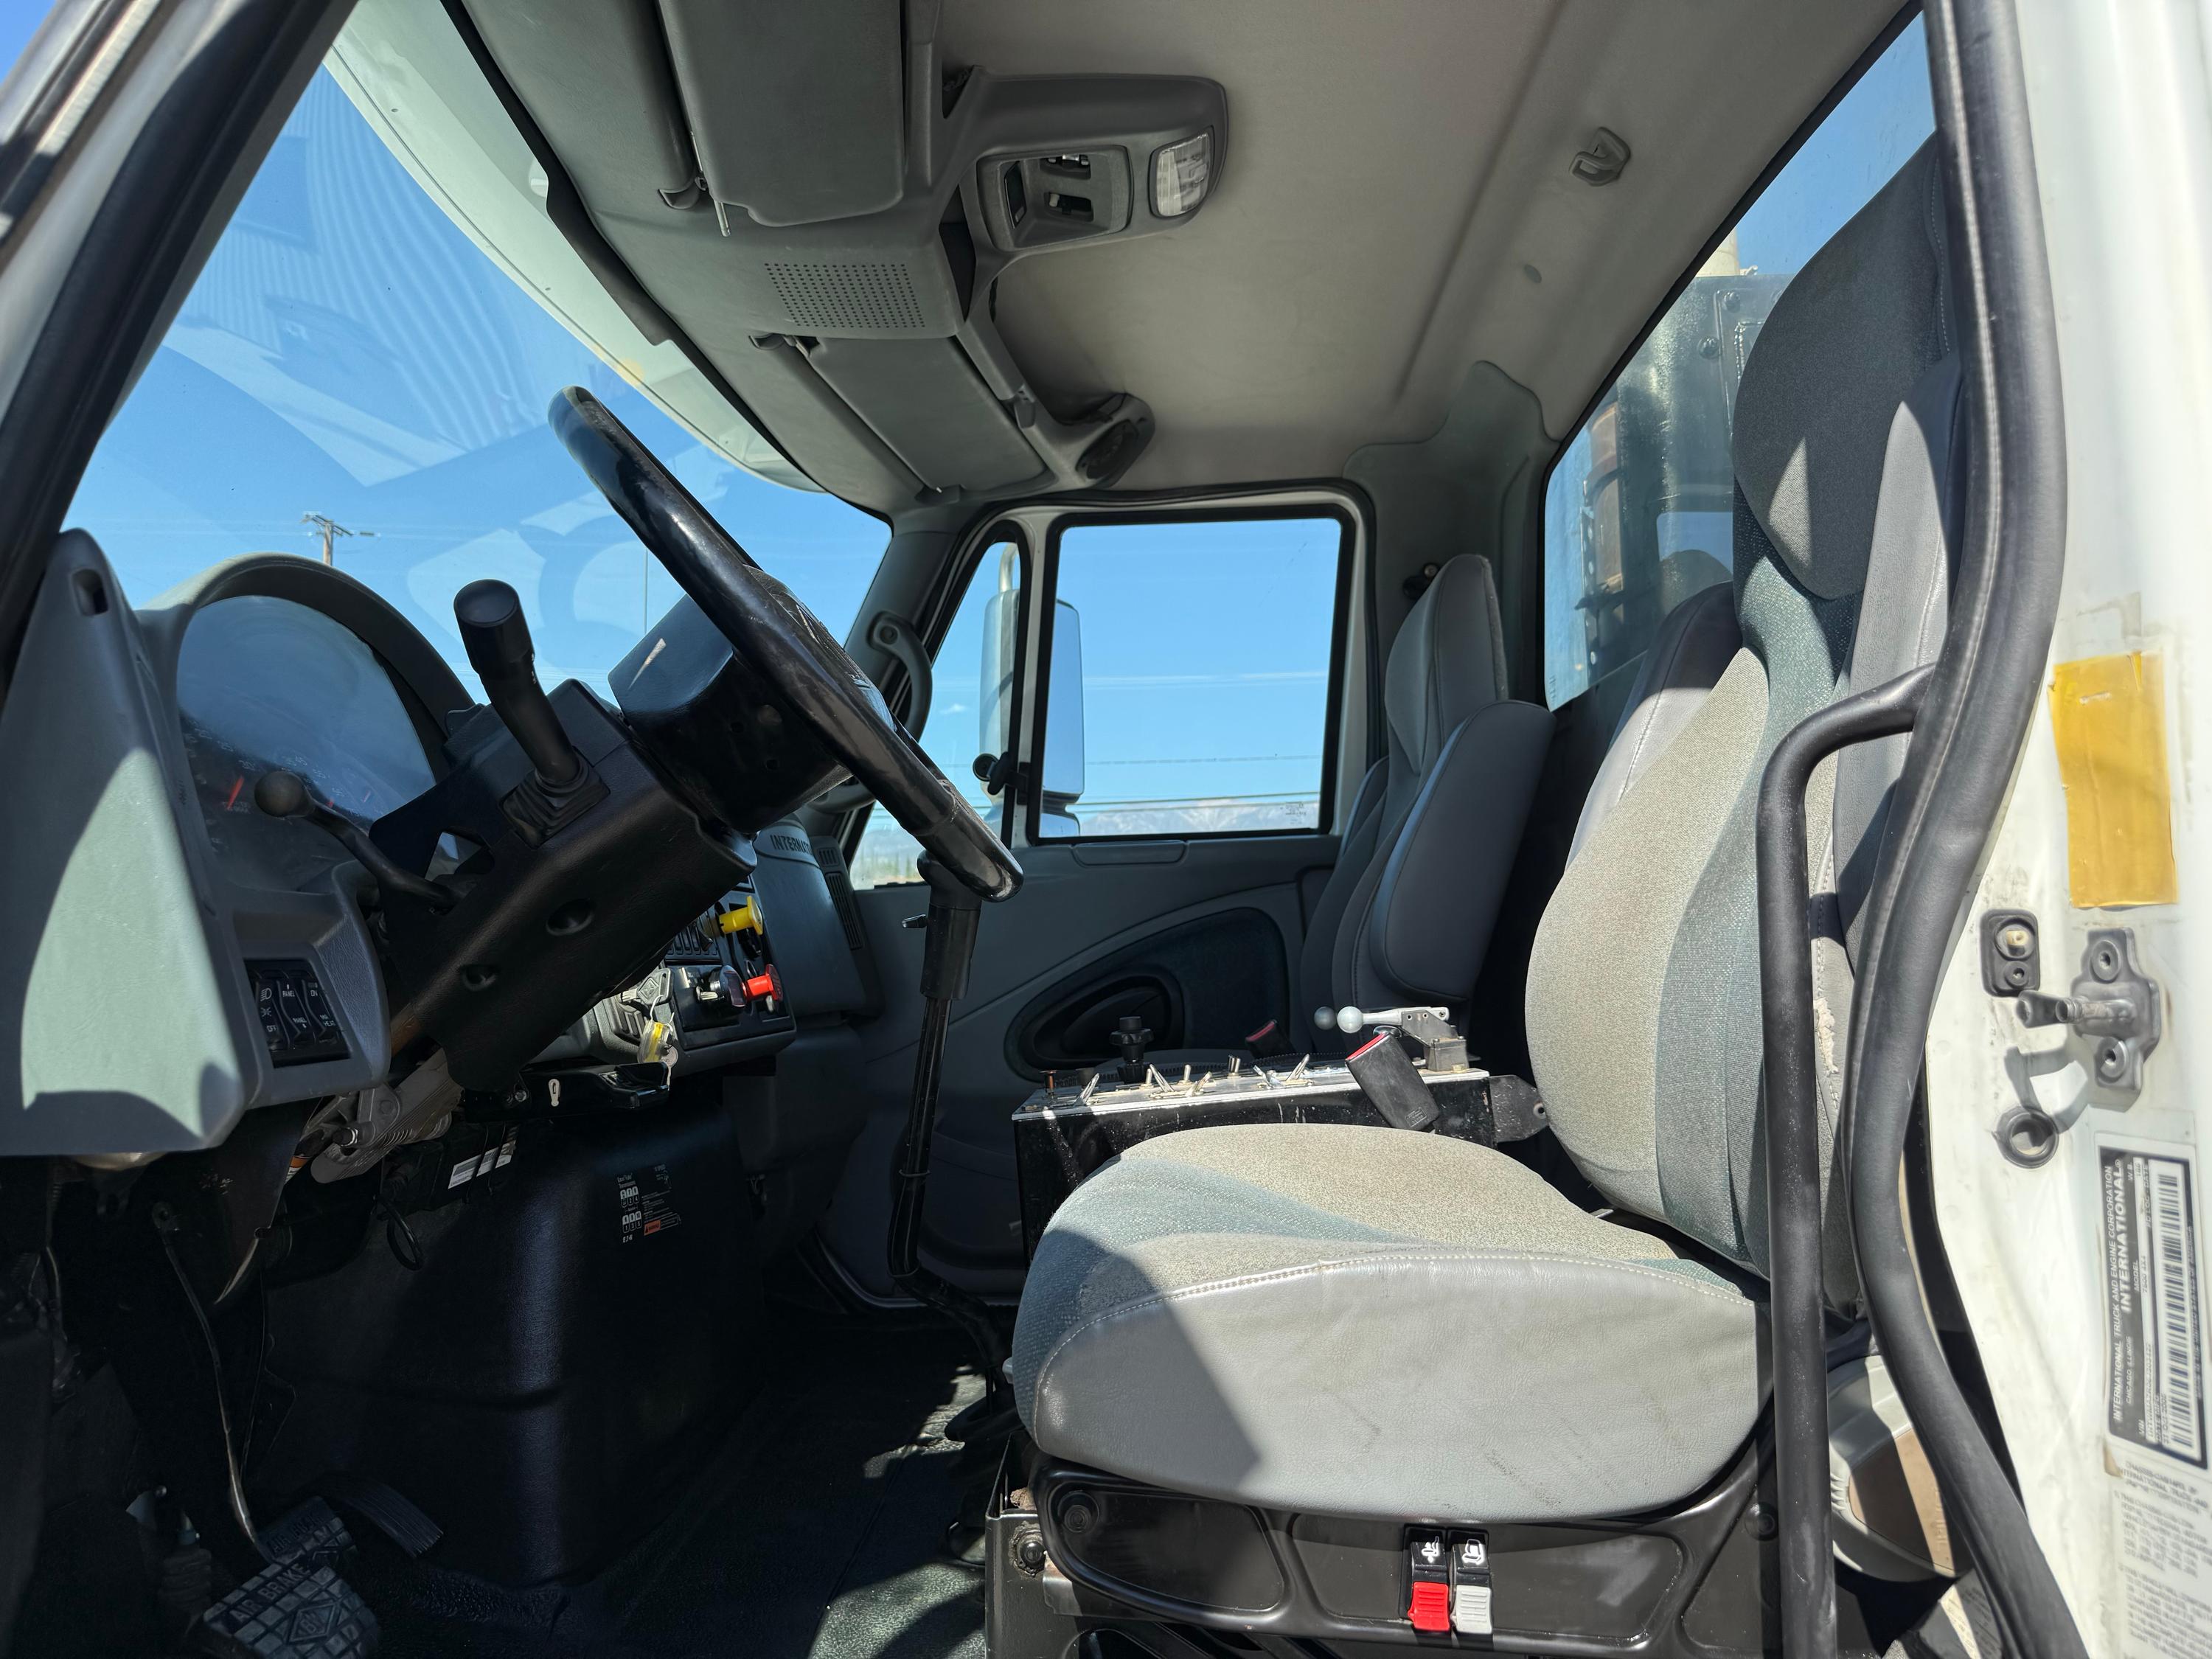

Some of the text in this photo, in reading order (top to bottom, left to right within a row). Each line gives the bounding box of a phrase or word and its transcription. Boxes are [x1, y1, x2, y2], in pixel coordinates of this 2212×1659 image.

[282, 990, 296, 998] PANEL
[310, 990, 319, 998] ON
[2132, 1259, 2140, 1292] MODEL
[2104, 1165, 2123, 1422] INTERNATIONAL TRUCK AND ENGINE CORPORATION
[2138, 1419, 2146, 1436] VIN
[229, 1562, 312, 1623] AIR BRAKE
